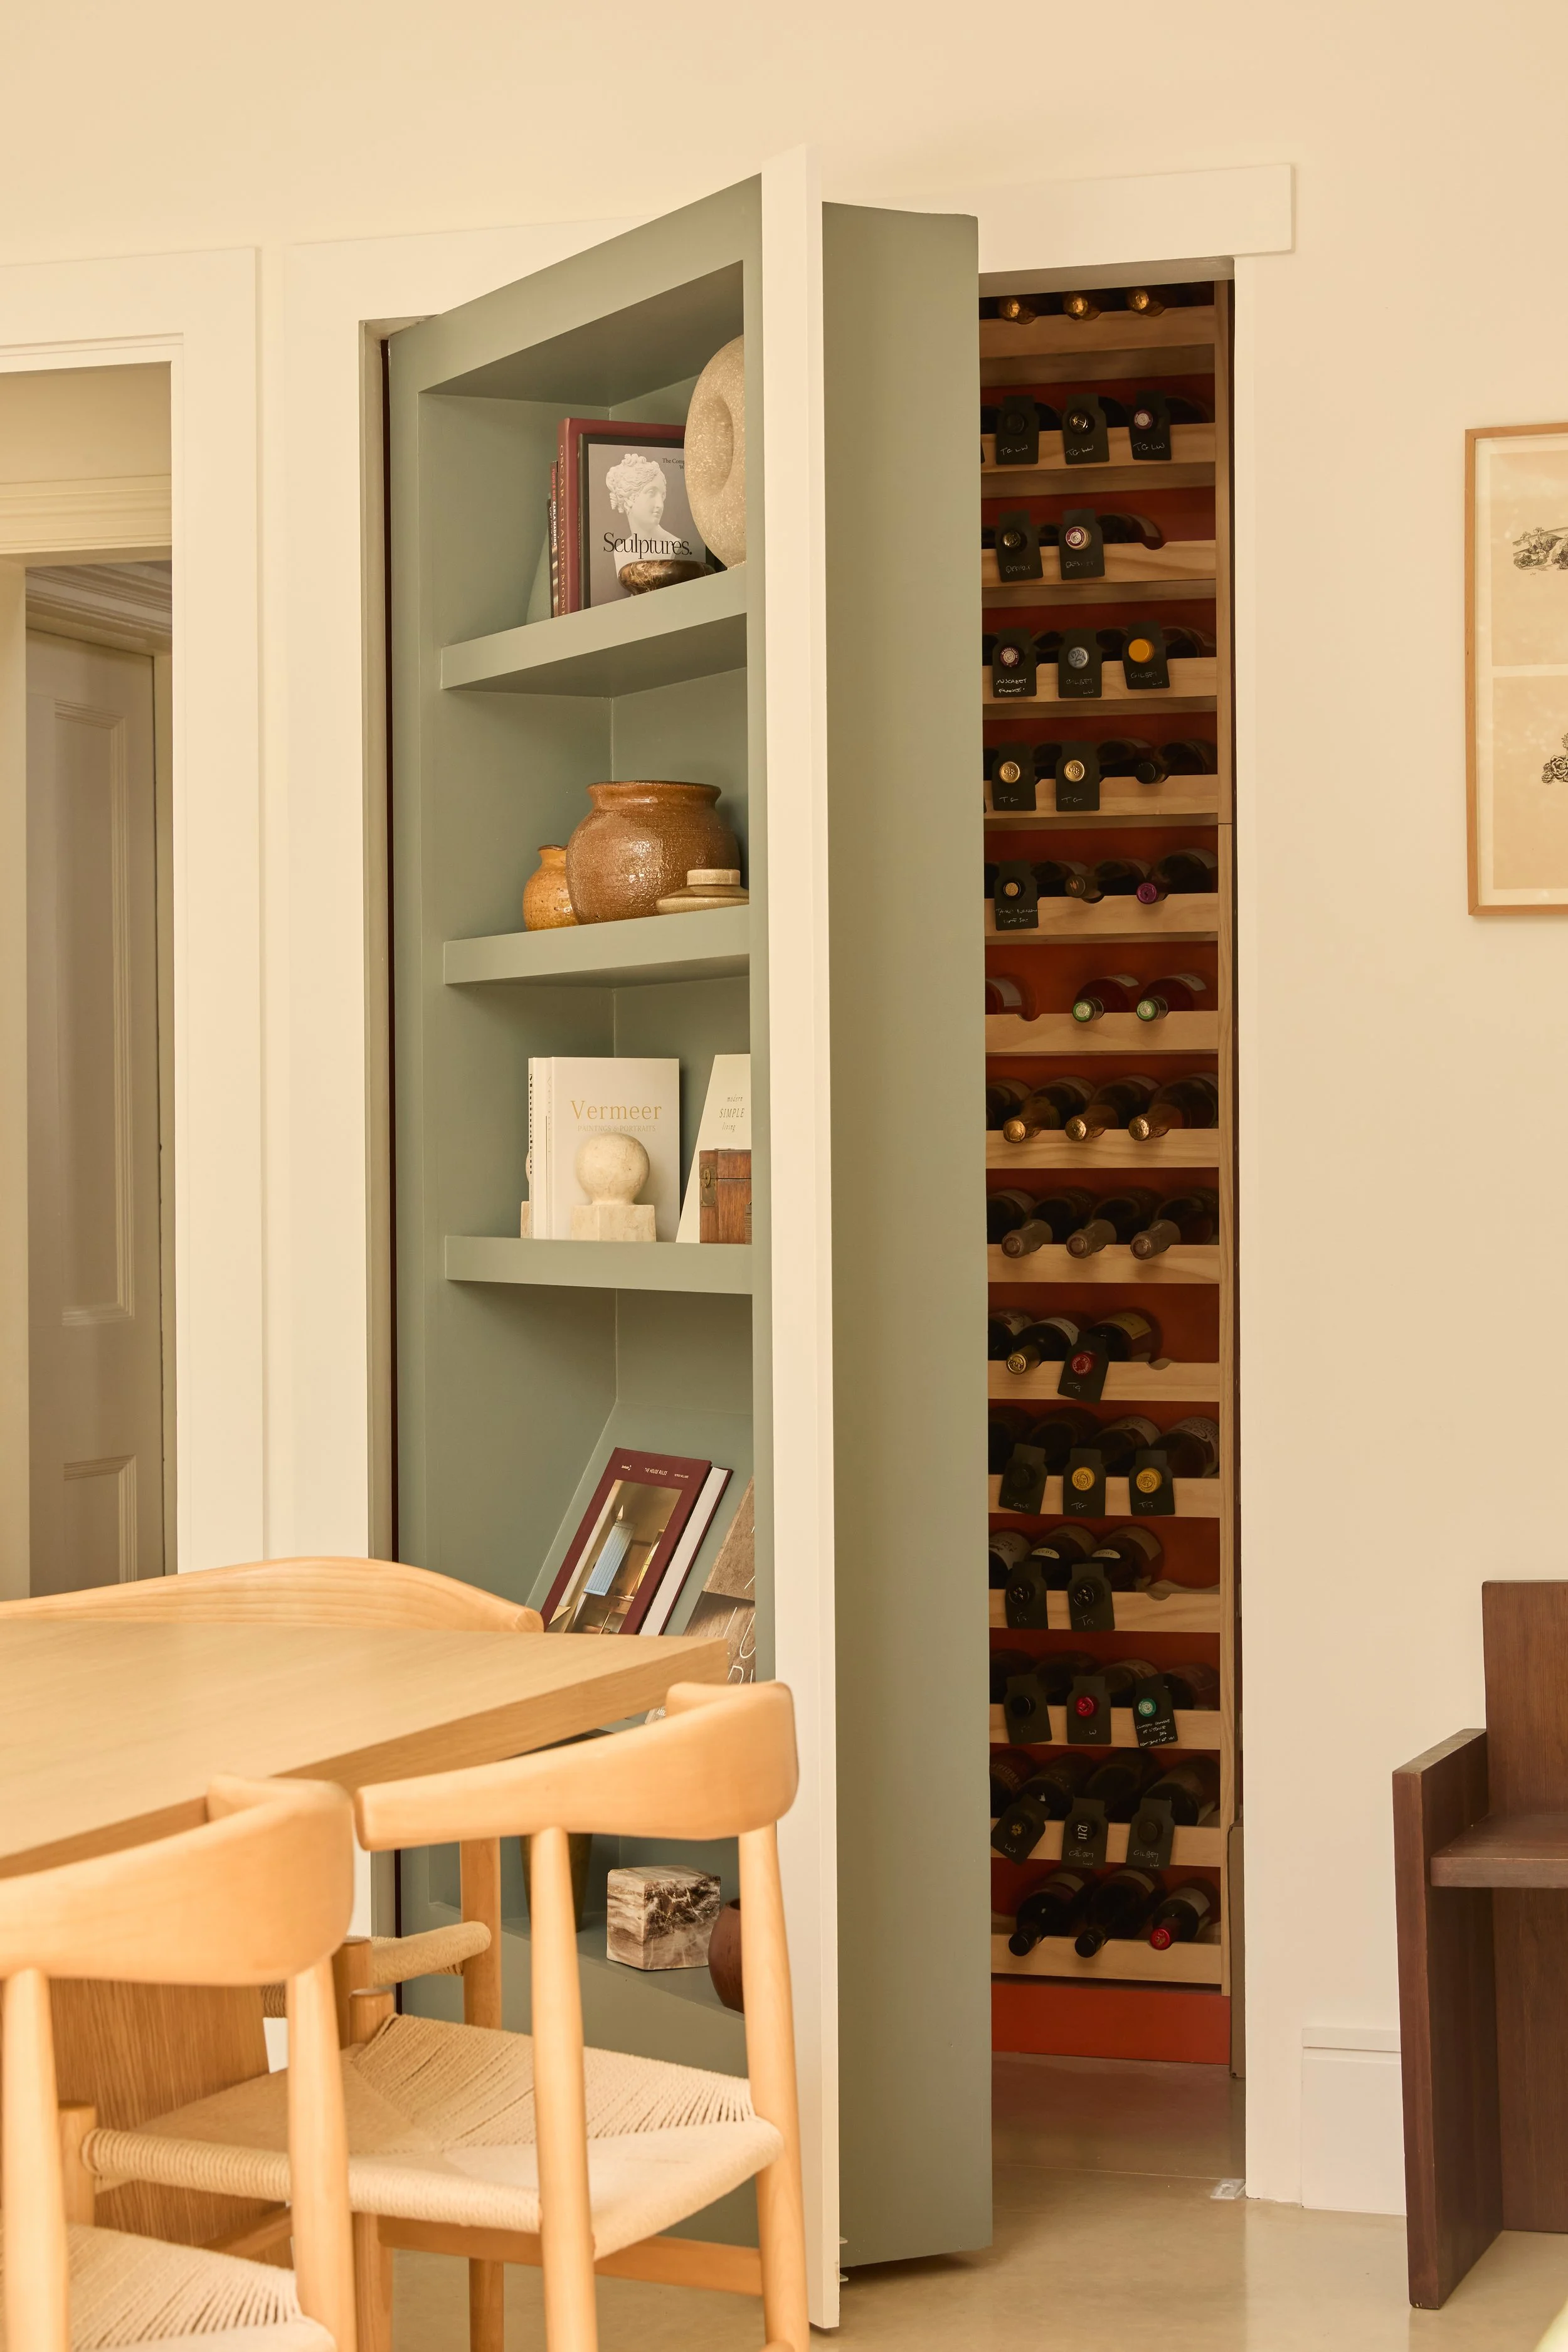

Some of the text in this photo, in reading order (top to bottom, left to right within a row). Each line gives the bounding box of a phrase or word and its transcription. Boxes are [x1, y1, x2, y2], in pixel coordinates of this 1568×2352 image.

[603, 532, 692, 559] Sculptures.
[726, 1093, 743, 1102] modern
[570, 1100, 662, 1120] Vermeer
[719, 1108, 745, 1118] SIMPLE
[722, 1121, 736, 1133] living
[1077, 1824, 1088, 1840] RH
